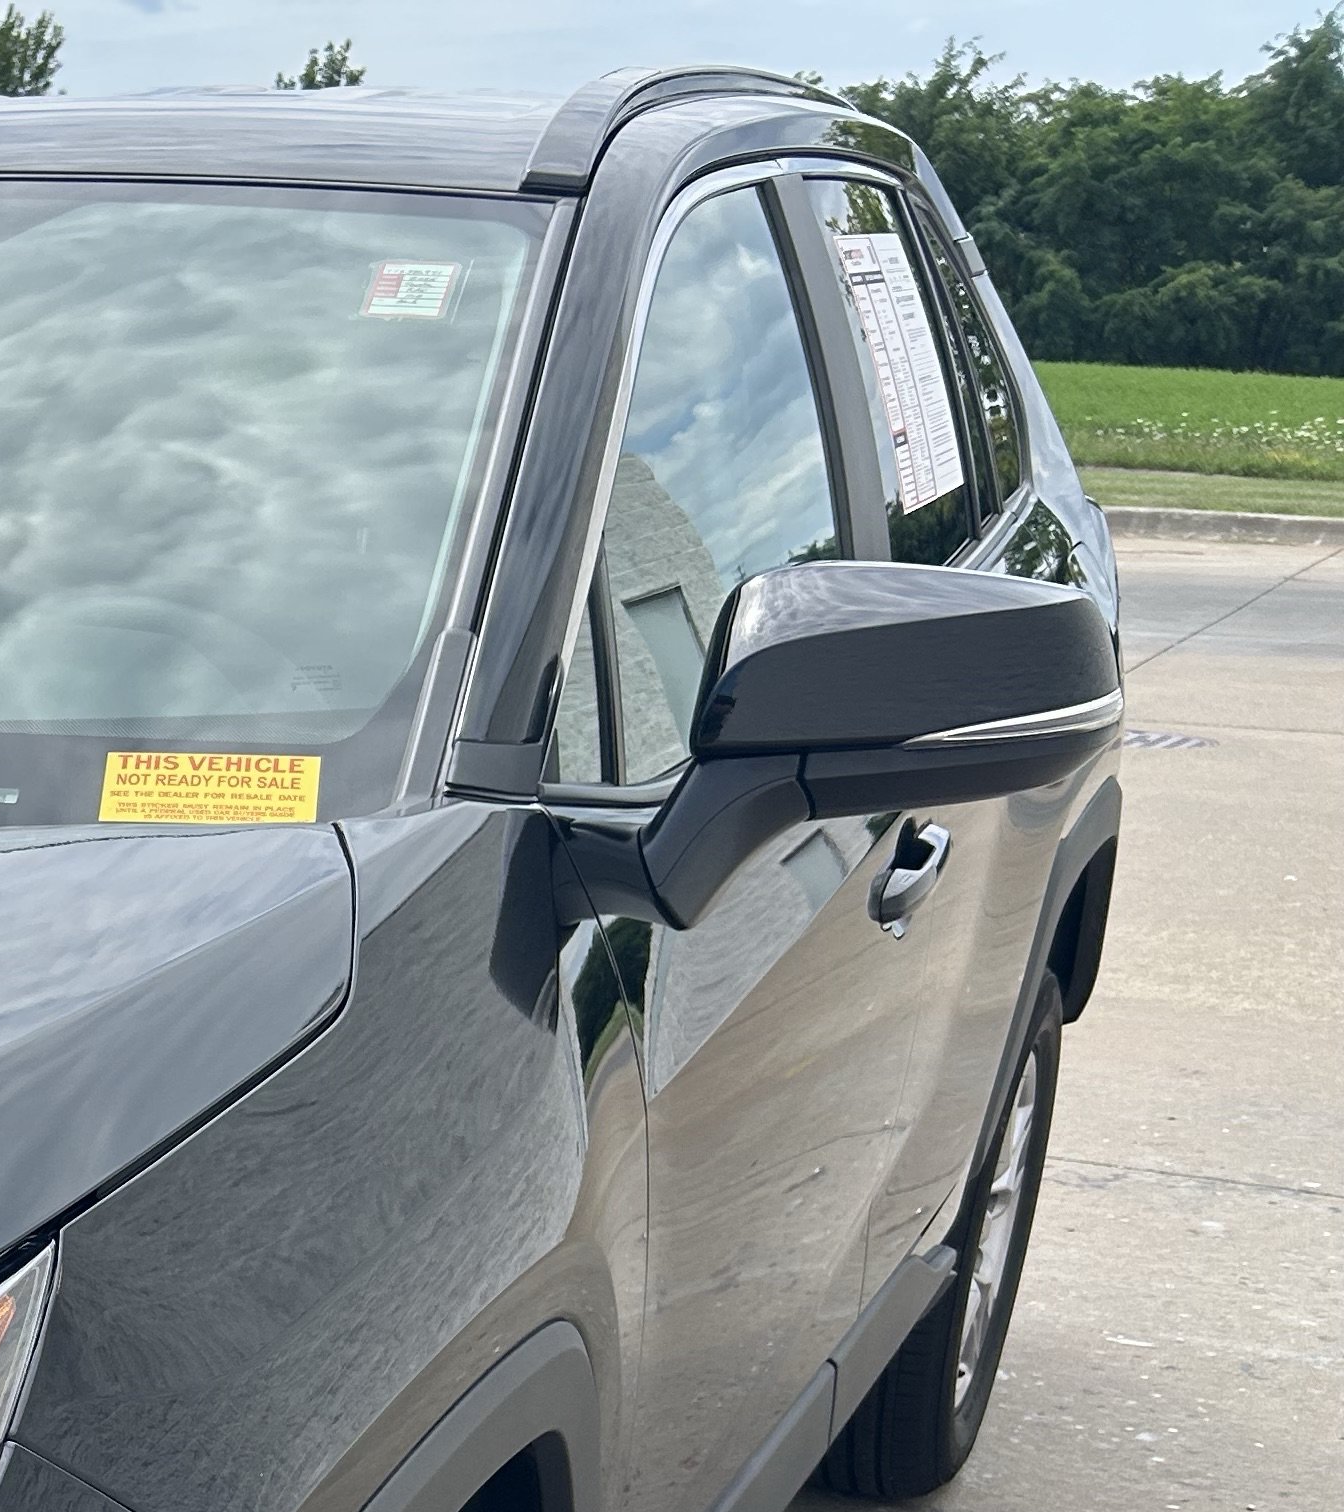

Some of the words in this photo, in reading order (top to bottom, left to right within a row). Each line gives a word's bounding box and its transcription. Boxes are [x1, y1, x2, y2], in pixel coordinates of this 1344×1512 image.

[118, 754, 180, 771] THIS
[188, 756, 305, 774] VEHICLE
[116, 773, 152, 786] NOT
[155, 774, 214, 788] READY
[217, 775, 252, 789] FOR
[256, 776, 302, 790] SALE
[134, 790, 154, 798] THE
[158, 791, 200, 799] DEALER
[204, 792, 226, 800] FOR
[230, 793, 274, 801] RESALE
[278, 794, 306, 802] DATE
